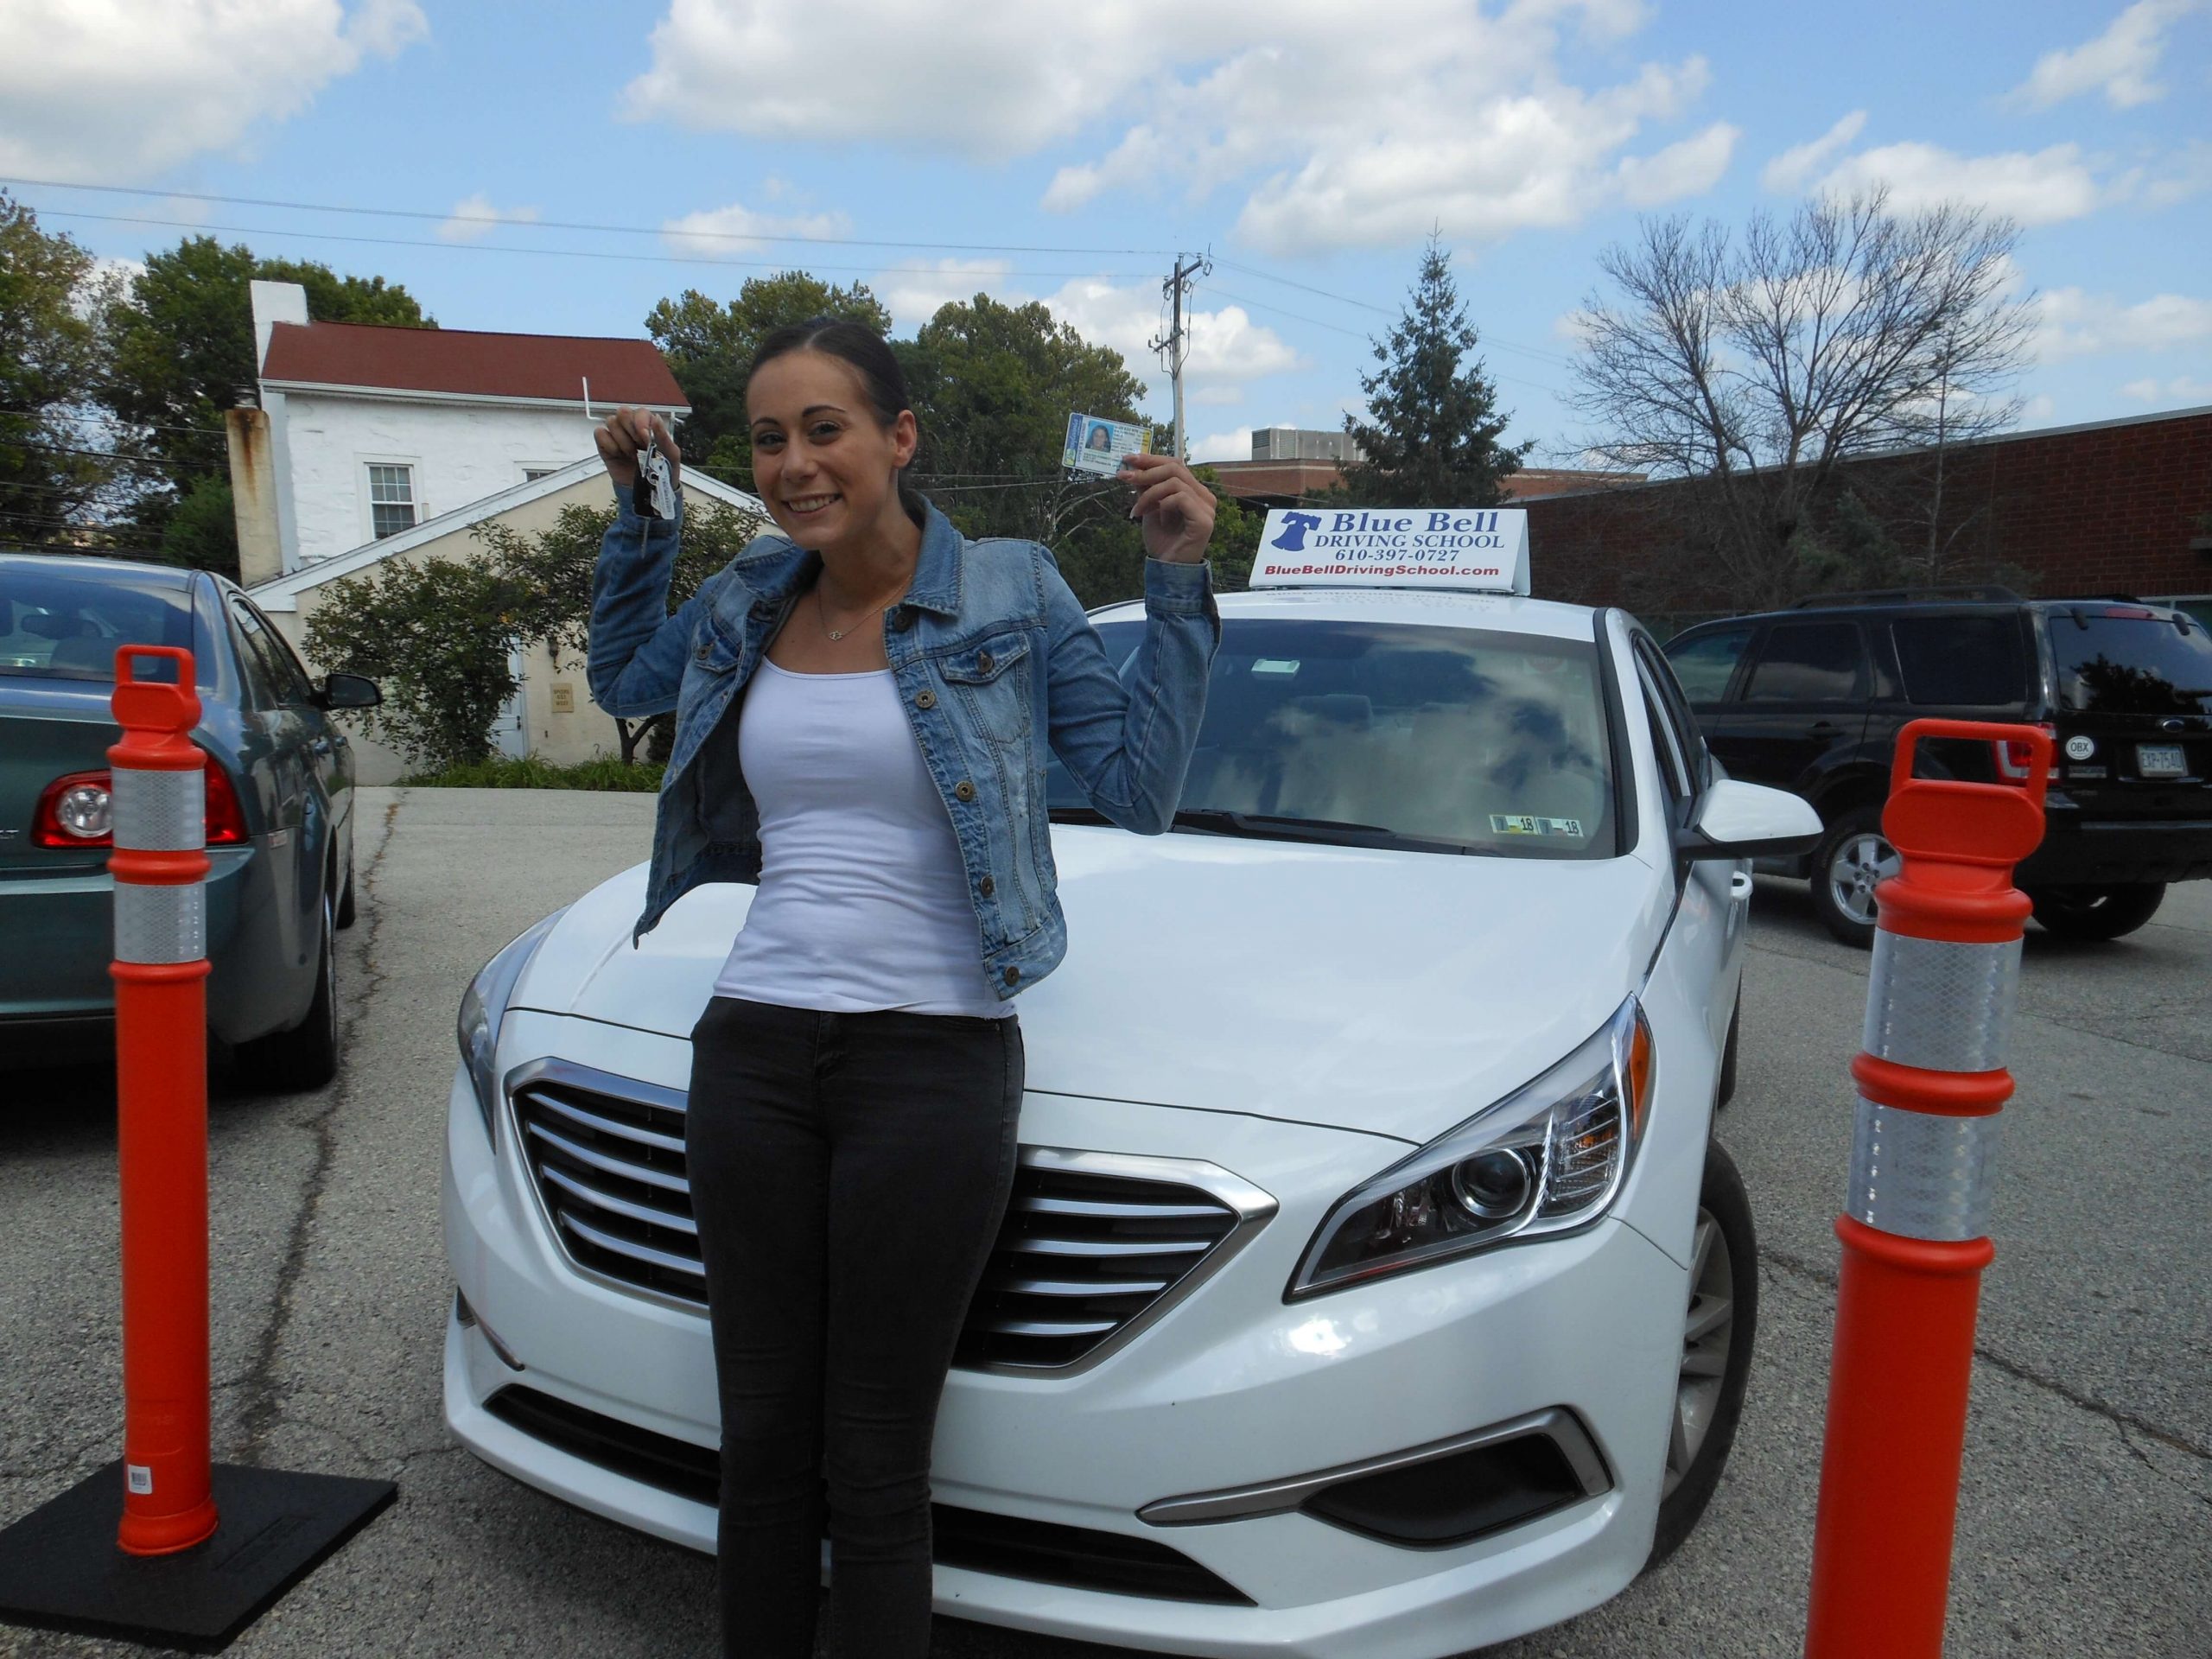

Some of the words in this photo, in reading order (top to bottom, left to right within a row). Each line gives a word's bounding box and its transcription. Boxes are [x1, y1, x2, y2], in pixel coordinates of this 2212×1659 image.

[1329, 512, 1413, 532] Blue
[1424, 512, 1498, 532] Bell
[1313, 535, 1407, 547] DRIVING
[1412, 535, 1505, 548] SCHOOL
[1335, 549, 1459, 562] 610-397-0727
[1264, 564, 1499, 577] BlueBellDrivingSchool.com
[2070, 742, 2089, 753] OBX
[1520, 817, 1535, 831] 18
[1565, 820, 1580, 834] 18
